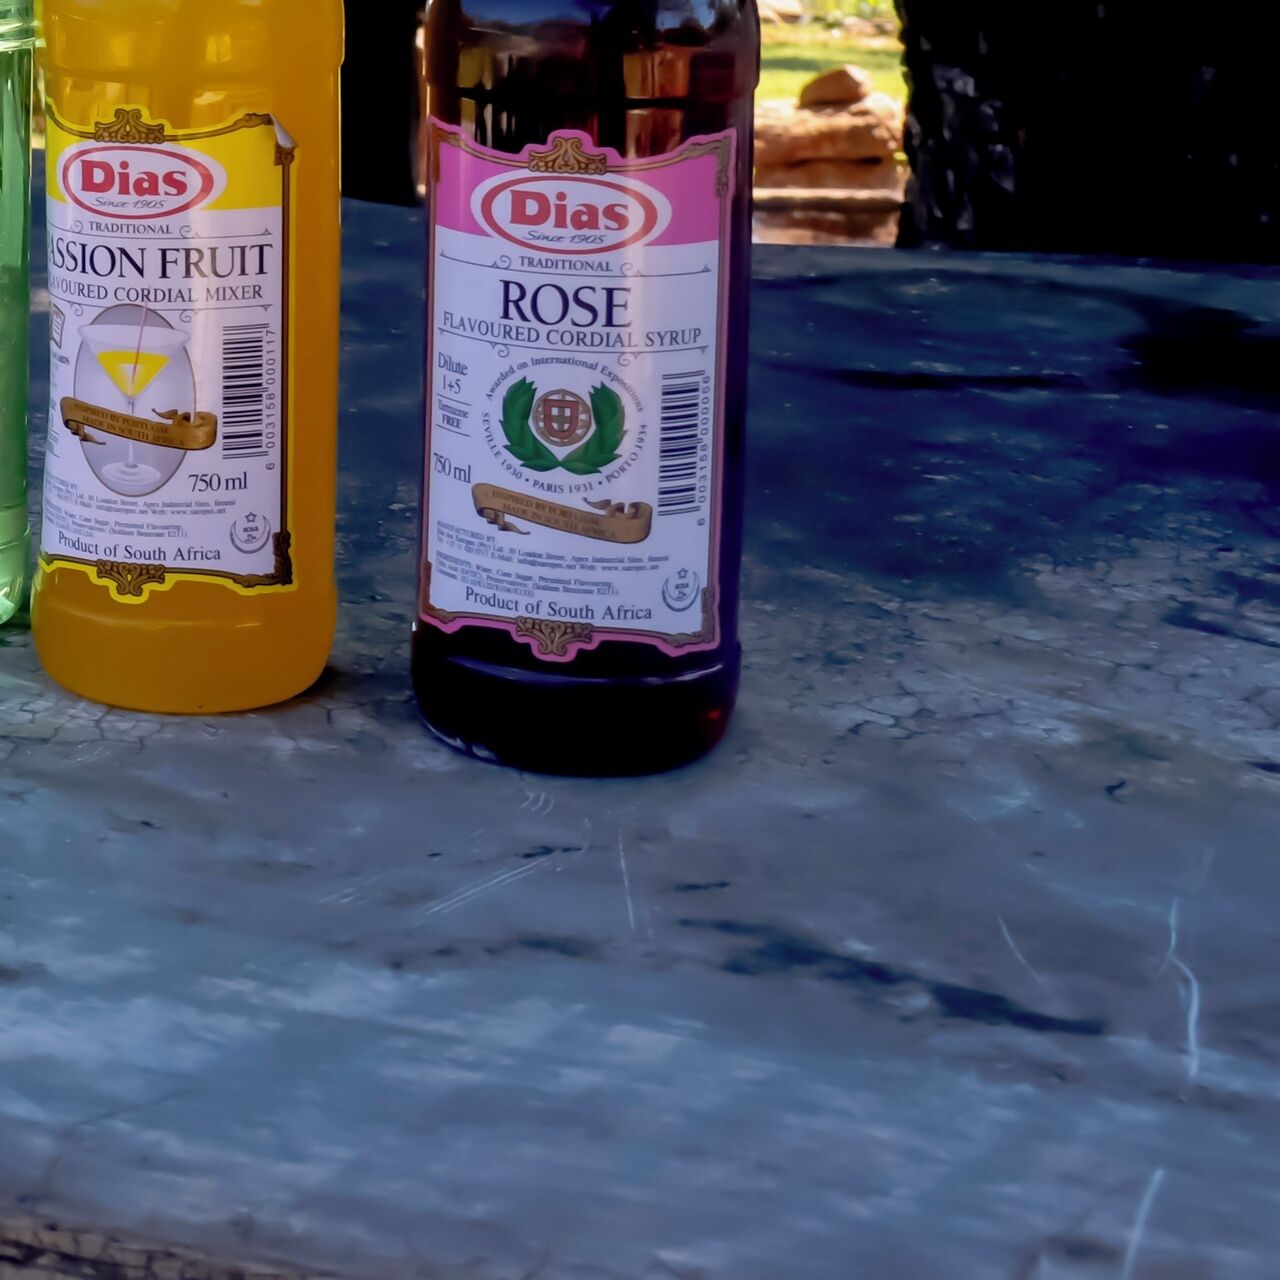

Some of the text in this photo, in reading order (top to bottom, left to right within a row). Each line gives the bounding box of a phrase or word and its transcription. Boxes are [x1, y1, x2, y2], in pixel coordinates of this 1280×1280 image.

[80, 159, 188, 197] Dias
[88, 221, 174, 235] TRADITIONAL
[509, 189, 630, 231] Dias
[158, 243, 274, 280] FRUIT
[518, 256, 613, 272] TRADITIONAL
[114, 286, 199, 303] CORDIAL
[206, 284, 263, 302] MIXER
[499, 279, 633, 328] ROSE
[443, 311, 702, 348] FLAVOURED CORDIAL SYRUP
[265, 329, 278, 385] 000117
[438, 351, 468, 376] Dilute
[485, 355, 644, 413] Awarded on International Expositions
[265, 392, 277, 449] 003158
[700, 375, 711, 436] 000056
[265, 462, 276, 471] 6
[481, 411, 648, 494] SEVILLE 1930 PARIS 1931 PORTO 1934
[188, 471, 248, 493] 750 ml
[453, 463, 472, 484] ml
[697, 443, 708, 504] 003158
[58, 530, 221, 561] Product of South Africa
[465, 586, 653, 620] Product of South Africa
